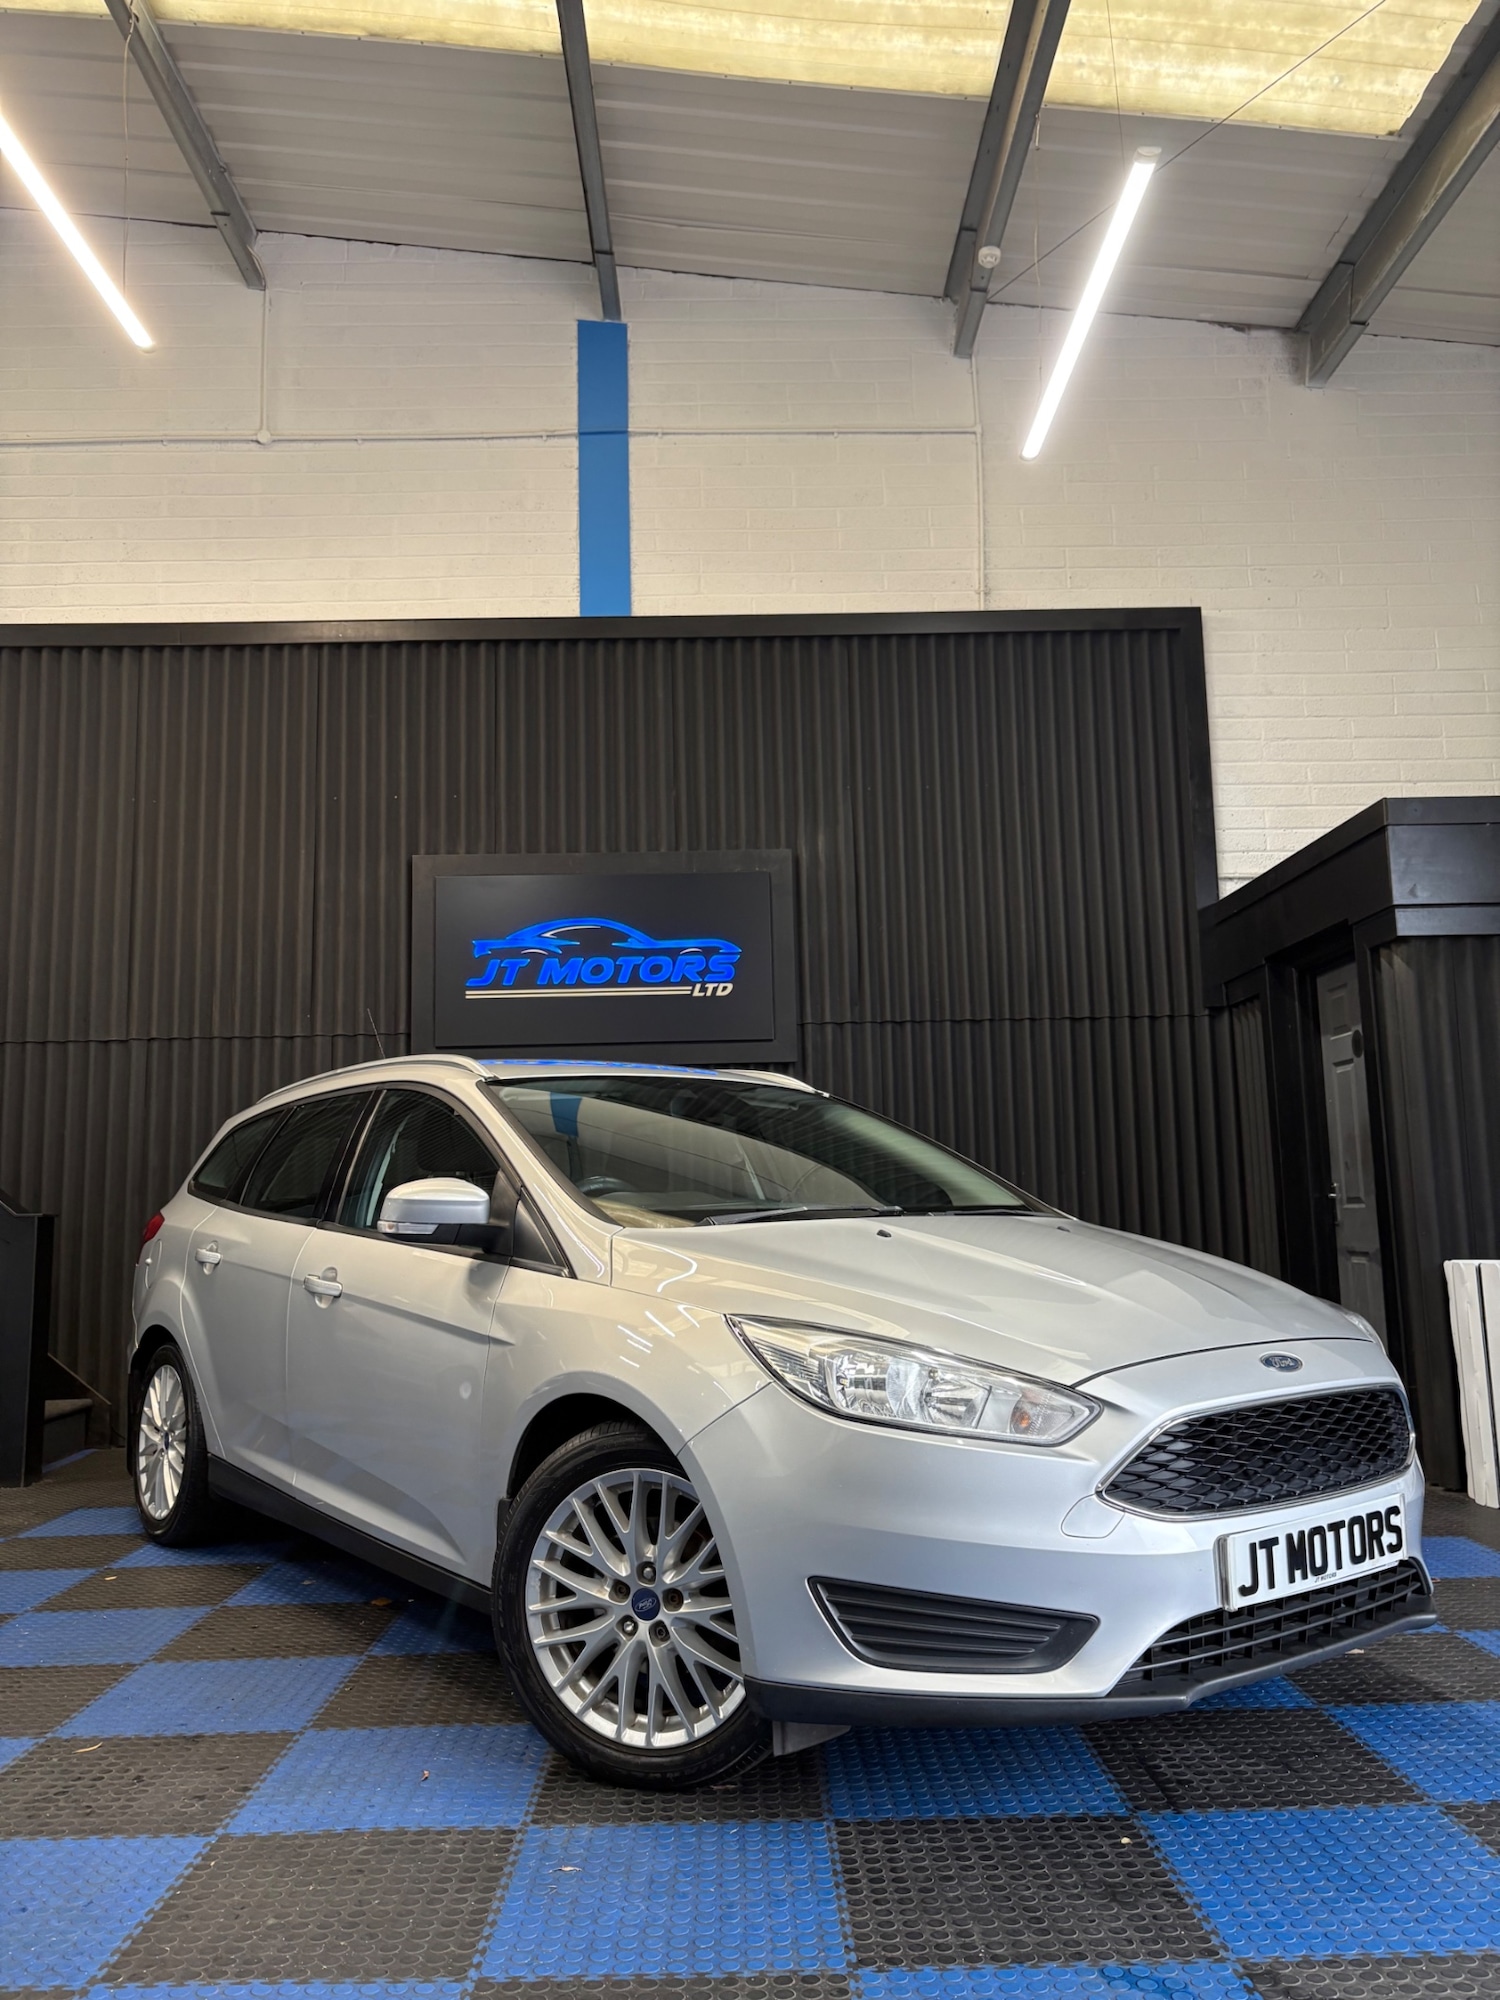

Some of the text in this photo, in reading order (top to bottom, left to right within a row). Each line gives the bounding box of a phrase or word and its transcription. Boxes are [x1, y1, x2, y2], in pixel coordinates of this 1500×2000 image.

[465, 954, 740, 987] JT MOTORS
[692, 982, 734, 997] LTD
[1238, 1505, 1404, 1597] JT MOTORS
